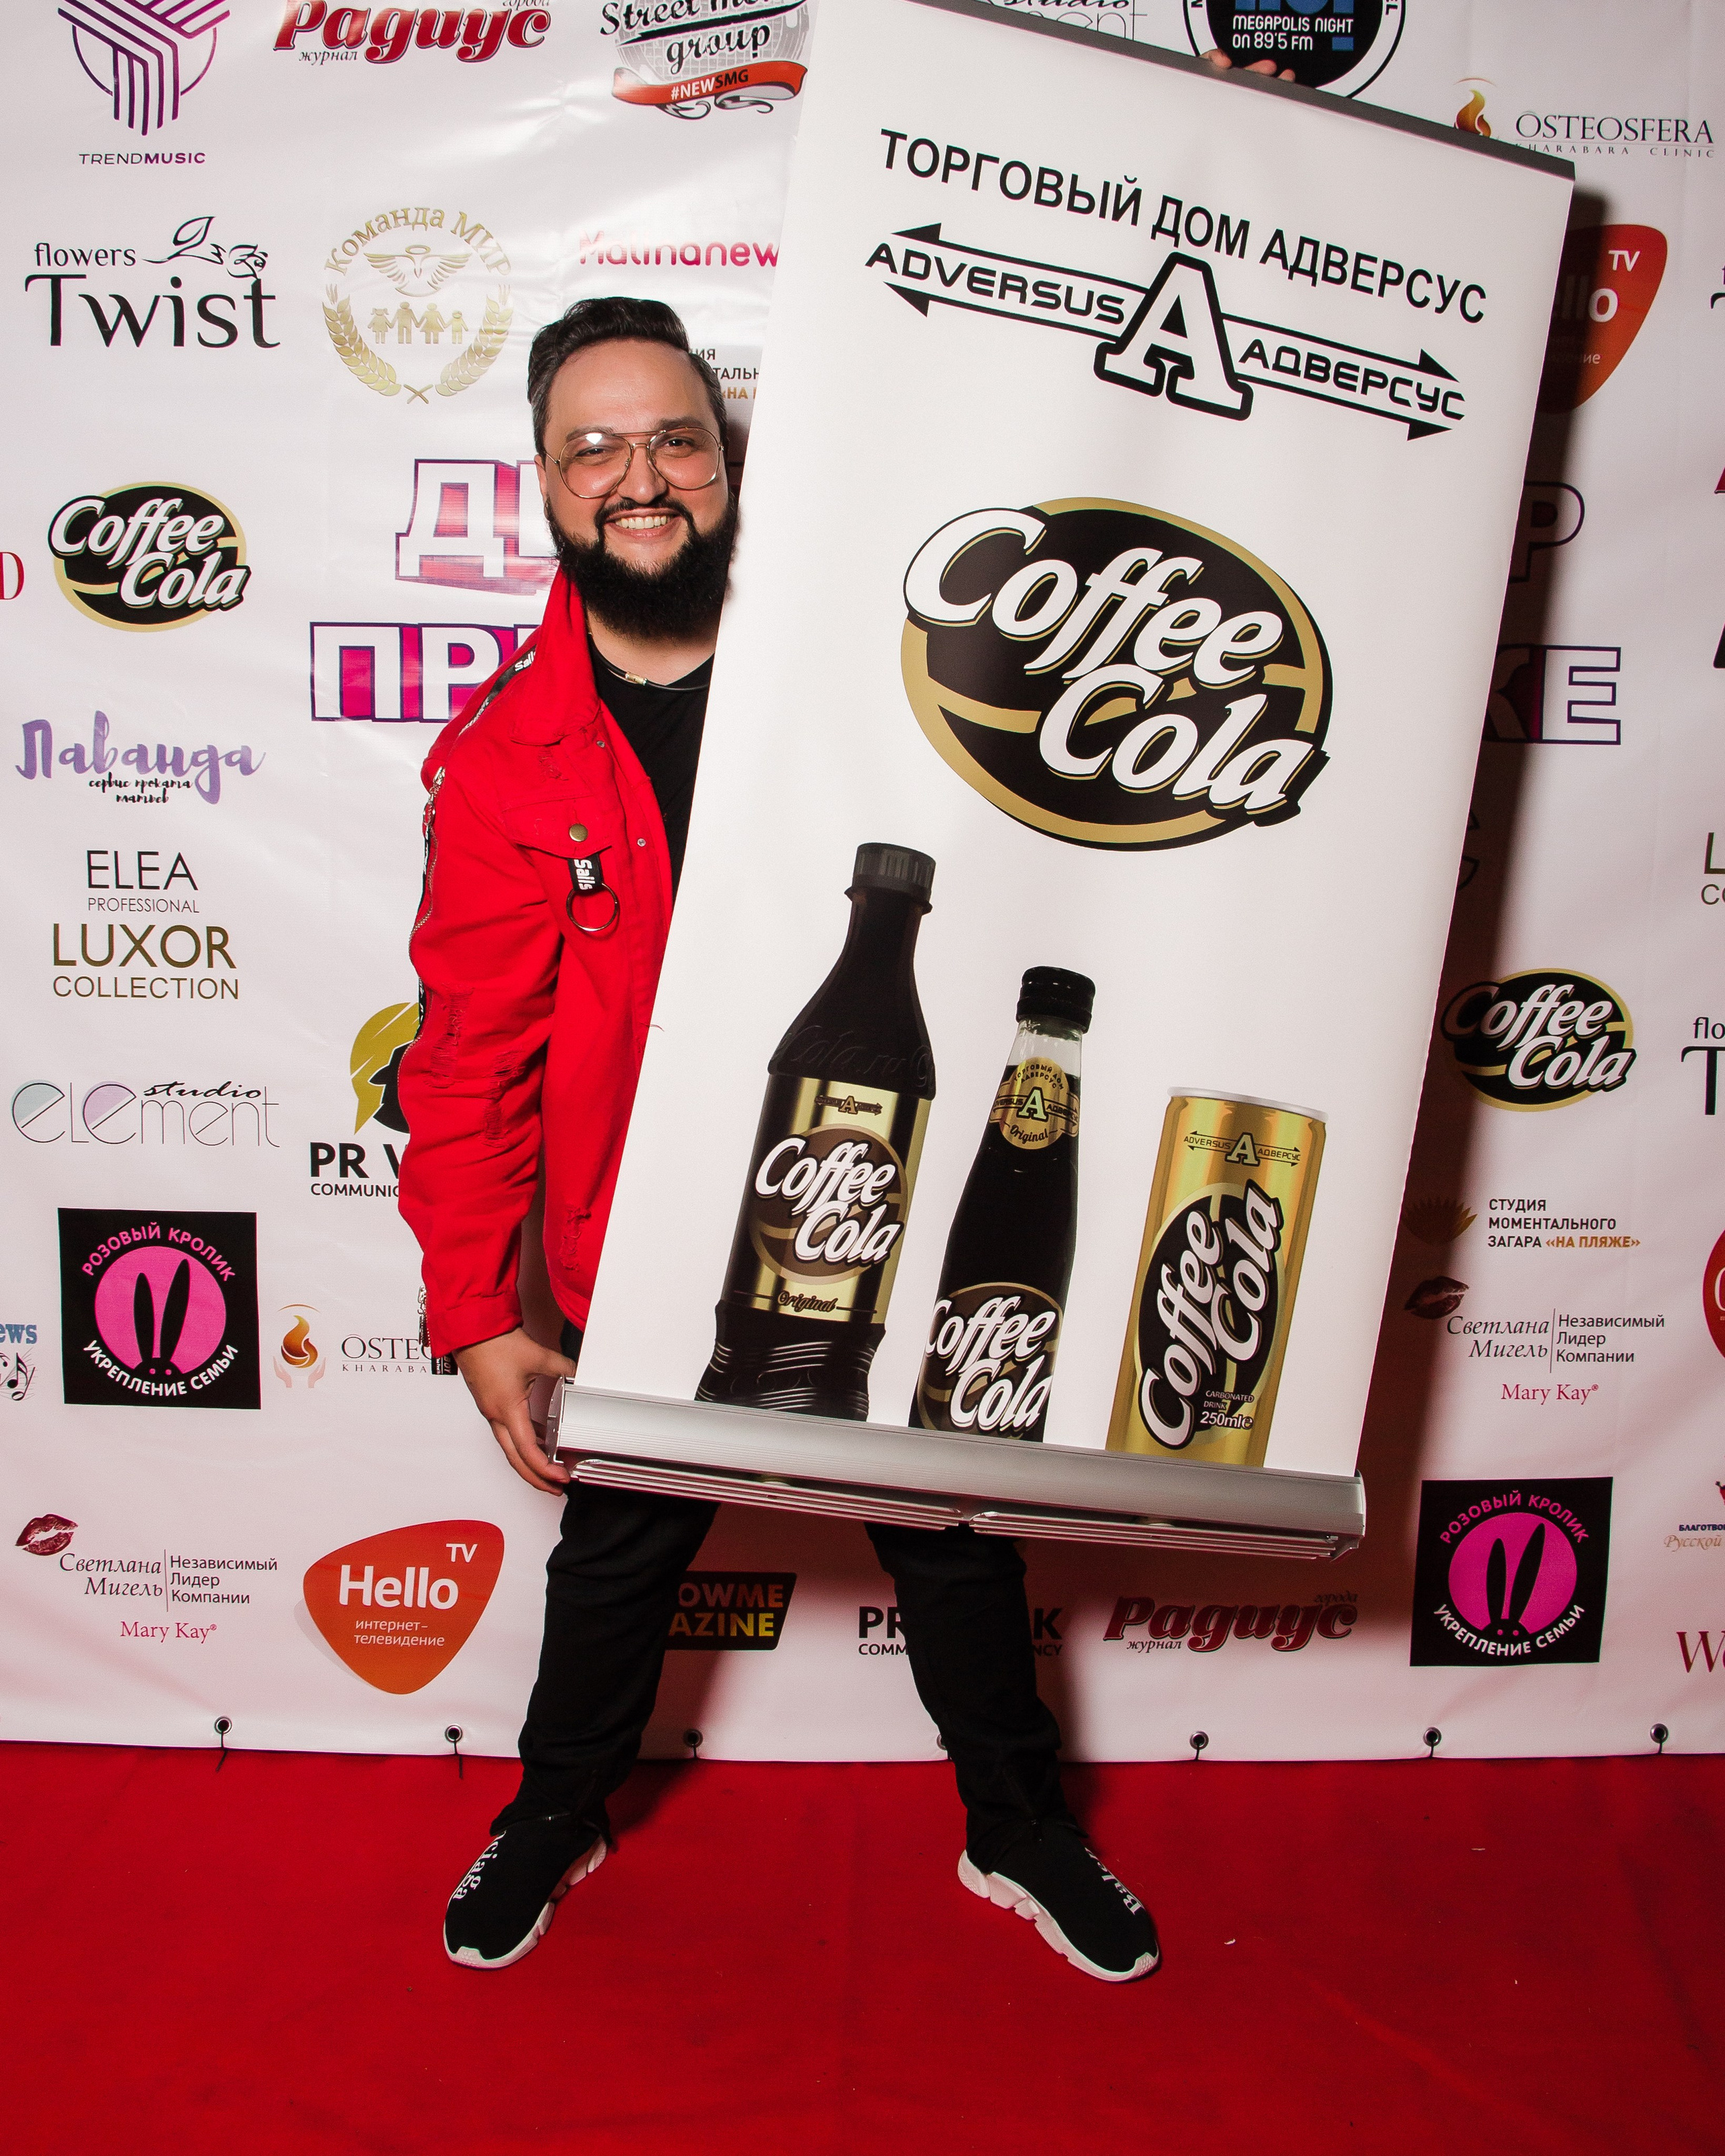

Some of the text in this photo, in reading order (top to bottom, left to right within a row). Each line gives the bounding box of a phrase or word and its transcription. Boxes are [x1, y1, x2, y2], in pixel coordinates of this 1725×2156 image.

[273, 0, 551, 63] Радиус
[299, 50, 358, 65] журнал
[666, 24, 770, 75] group
[670, 69, 749, 100] #NEWSMG
[1515, 114, 1714, 144] OSTEOSFERA
[79, 152, 206, 165] TRENDMUSIC
[1650, 147, 1715, 158] CLINIC
[880, 129, 1487, 323] ТОРГОВЫЙ ДОМ АДВЕРСУС
[324, 207, 511, 276] Команда МИР
[34, 243, 135, 267] flowers
[1608, 250, 1639, 272] TV
[24, 274, 280, 348] Twist
[865, 242, 1466, 420] ADVERSUS A АДВЕРСУС
[51, 497, 225, 568] Coffee
[120, 551, 249, 610] Cola
[906, 507, 1283, 684] Coffee
[1039, 664, 1314, 811] Cola
[15, 711, 265, 804] Лаванда
[86, 850, 198, 891] ELEA
[88, 897, 199, 914] PROFESSIONAL
[53, 923, 237, 969] LUXOR
[53, 976, 239, 1000] COLLECTION
[1443, 984, 1612, 1050] Coffee
[1508, 1035, 1633, 1087] Cola
[143, 1081, 261, 1099] studio
[1010, 1124, 1048, 1144] Original
[310, 1142, 370, 1178] PR
[1183, 1135, 1231, 1151] ADVERSUS
[1257, 1148, 1300, 1162] АДВЕРСУС
[755, 1137, 896, 1216] Coffee
[1488, 1199, 1546, 1213] СТУДИЯ
[794, 1198, 901, 1263] Cola
[1488, 1217, 1617, 1230] МОМЕНТАЛЬНОГО
[81, 1222, 235, 1281] РОЗОВЫЙ КРОЛИК
[1487, 1236, 1542, 1248] ЗАГАРА
[1211, 1186, 1278, 1361] Cola
[778, 1290, 836, 1313] Original
[1141, 1211, 1220, 1446] Coffee
[1446, 1316, 1550, 1335] Светлана
[1558, 1314, 1665, 1328] Независимый
[926, 1297, 1055, 1375] Coffee
[1468, 1339, 1548, 1358] Мигель
[1557, 1331, 1606, 1347] Лидер
[1556, 1349, 1635, 1362] Компании
[83, 1340, 239, 1397] УКРЕПЛЕНИЕ СЕМЬИ
[951, 1356, 1054, 1432] Cola
[1203, 1401, 1225, 1409] DRINK
[1205, 1390, 1254, 1402] CARBONATED
[1501, 1383, 1551, 1405] Mary
[1440, 1490, 1589, 1544] РОЗОВЫЙ КРОЛИК
[446, 1543, 478, 1563] TV
[1664, 1535, 1722, 1552] Русской
[59, 1553, 162, 1575] Светлана
[170, 1554, 278, 1572] Независимый
[84, 1577, 163, 1599] Мигель
[170, 1572, 220, 1590] Лидер
[338, 1564, 458, 1610] Hello
[171, 1589, 251, 1605] Компании
[120, 1620, 170, 1643] Mary
[1103, 1596, 1357, 1652] Радиус
[1433, 1604, 1585, 1656] УКРЕПЛЕНИЕ СЕМЬИ
[354, 1634, 445, 1648] телевидение
[1127, 1639, 1182, 1653] журнал
